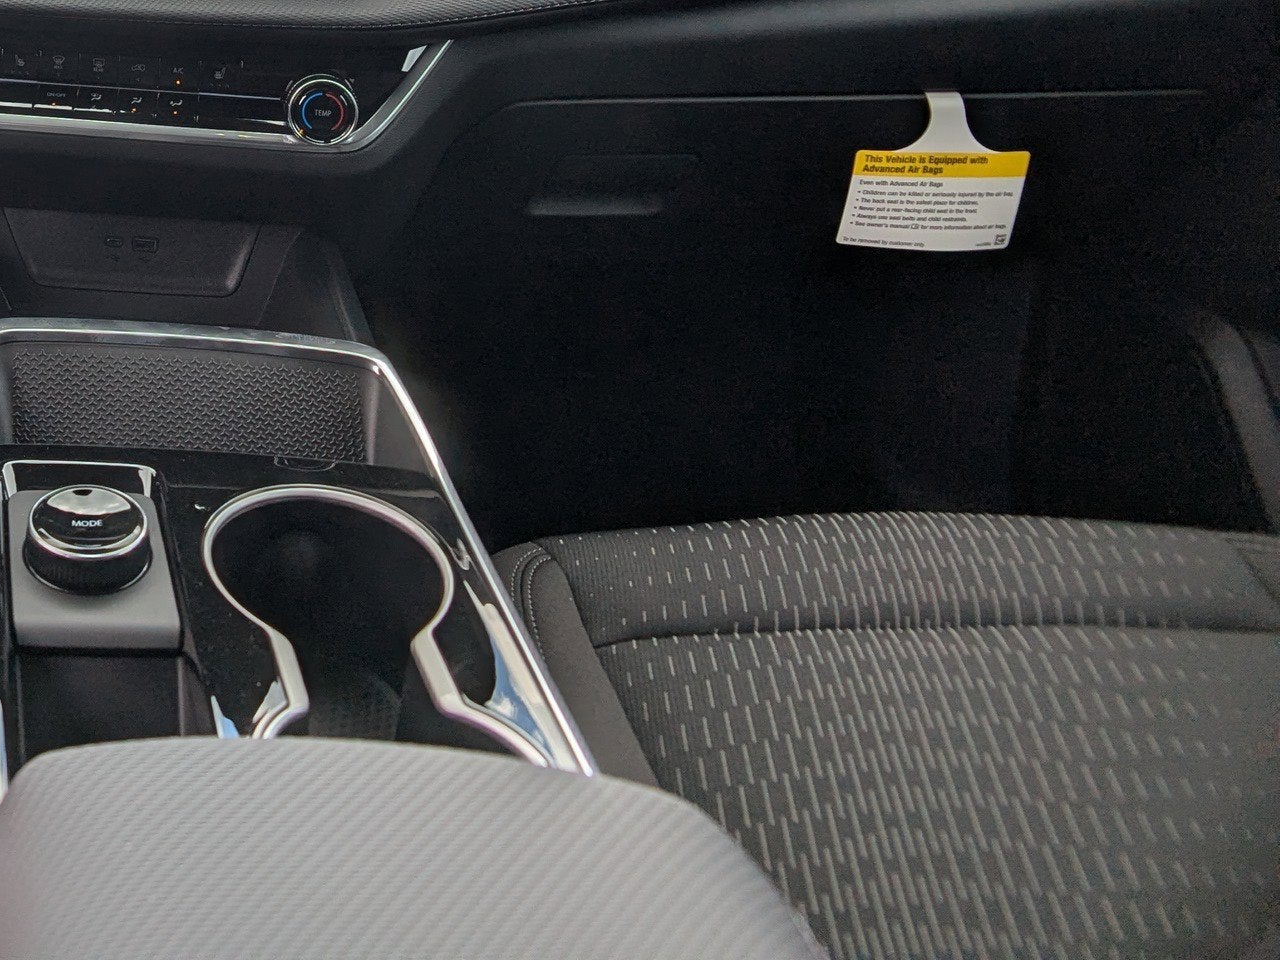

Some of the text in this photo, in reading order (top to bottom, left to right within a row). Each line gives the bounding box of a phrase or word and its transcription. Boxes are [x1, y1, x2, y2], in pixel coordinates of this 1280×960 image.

[314, 109, 332, 117] TEMP
[865, 154, 989, 165] This Vehicle is Equipped with
[862, 164, 943, 175] Advanced Air Bags
[71, 519, 104, 527] MODE
